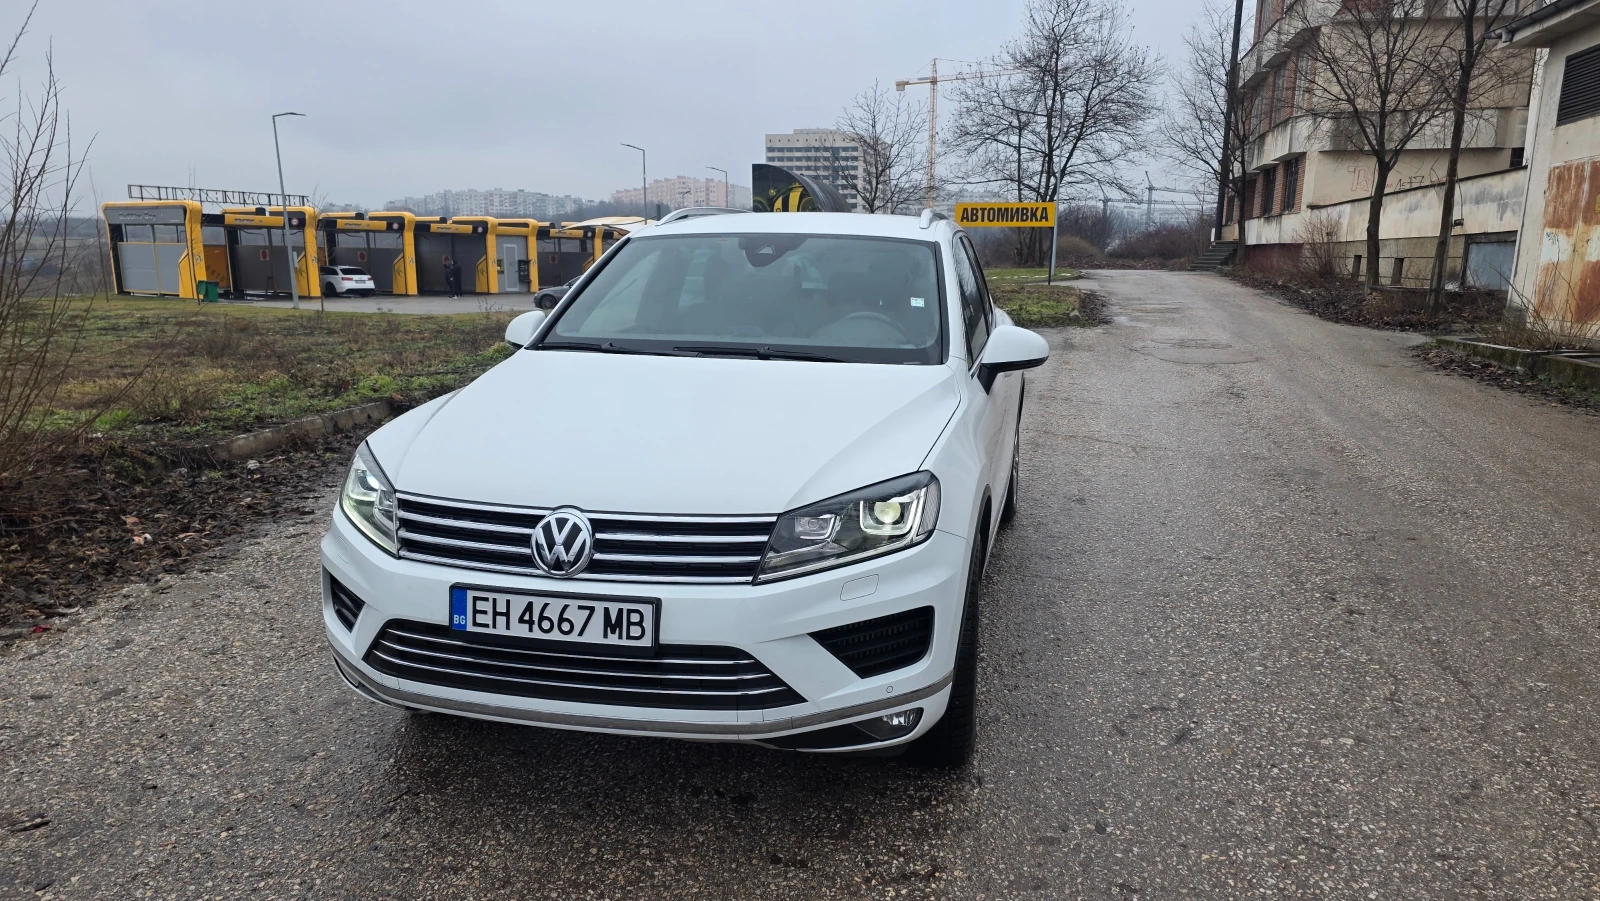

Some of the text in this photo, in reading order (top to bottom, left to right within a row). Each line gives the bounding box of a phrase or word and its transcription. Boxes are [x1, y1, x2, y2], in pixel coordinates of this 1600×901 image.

[960, 206, 1049, 222] АВТОМИВКА
[533, 511, 591, 575] VW
[453, 614, 466, 625] BG
[472, 595, 647, 641] EH 4667 MB
